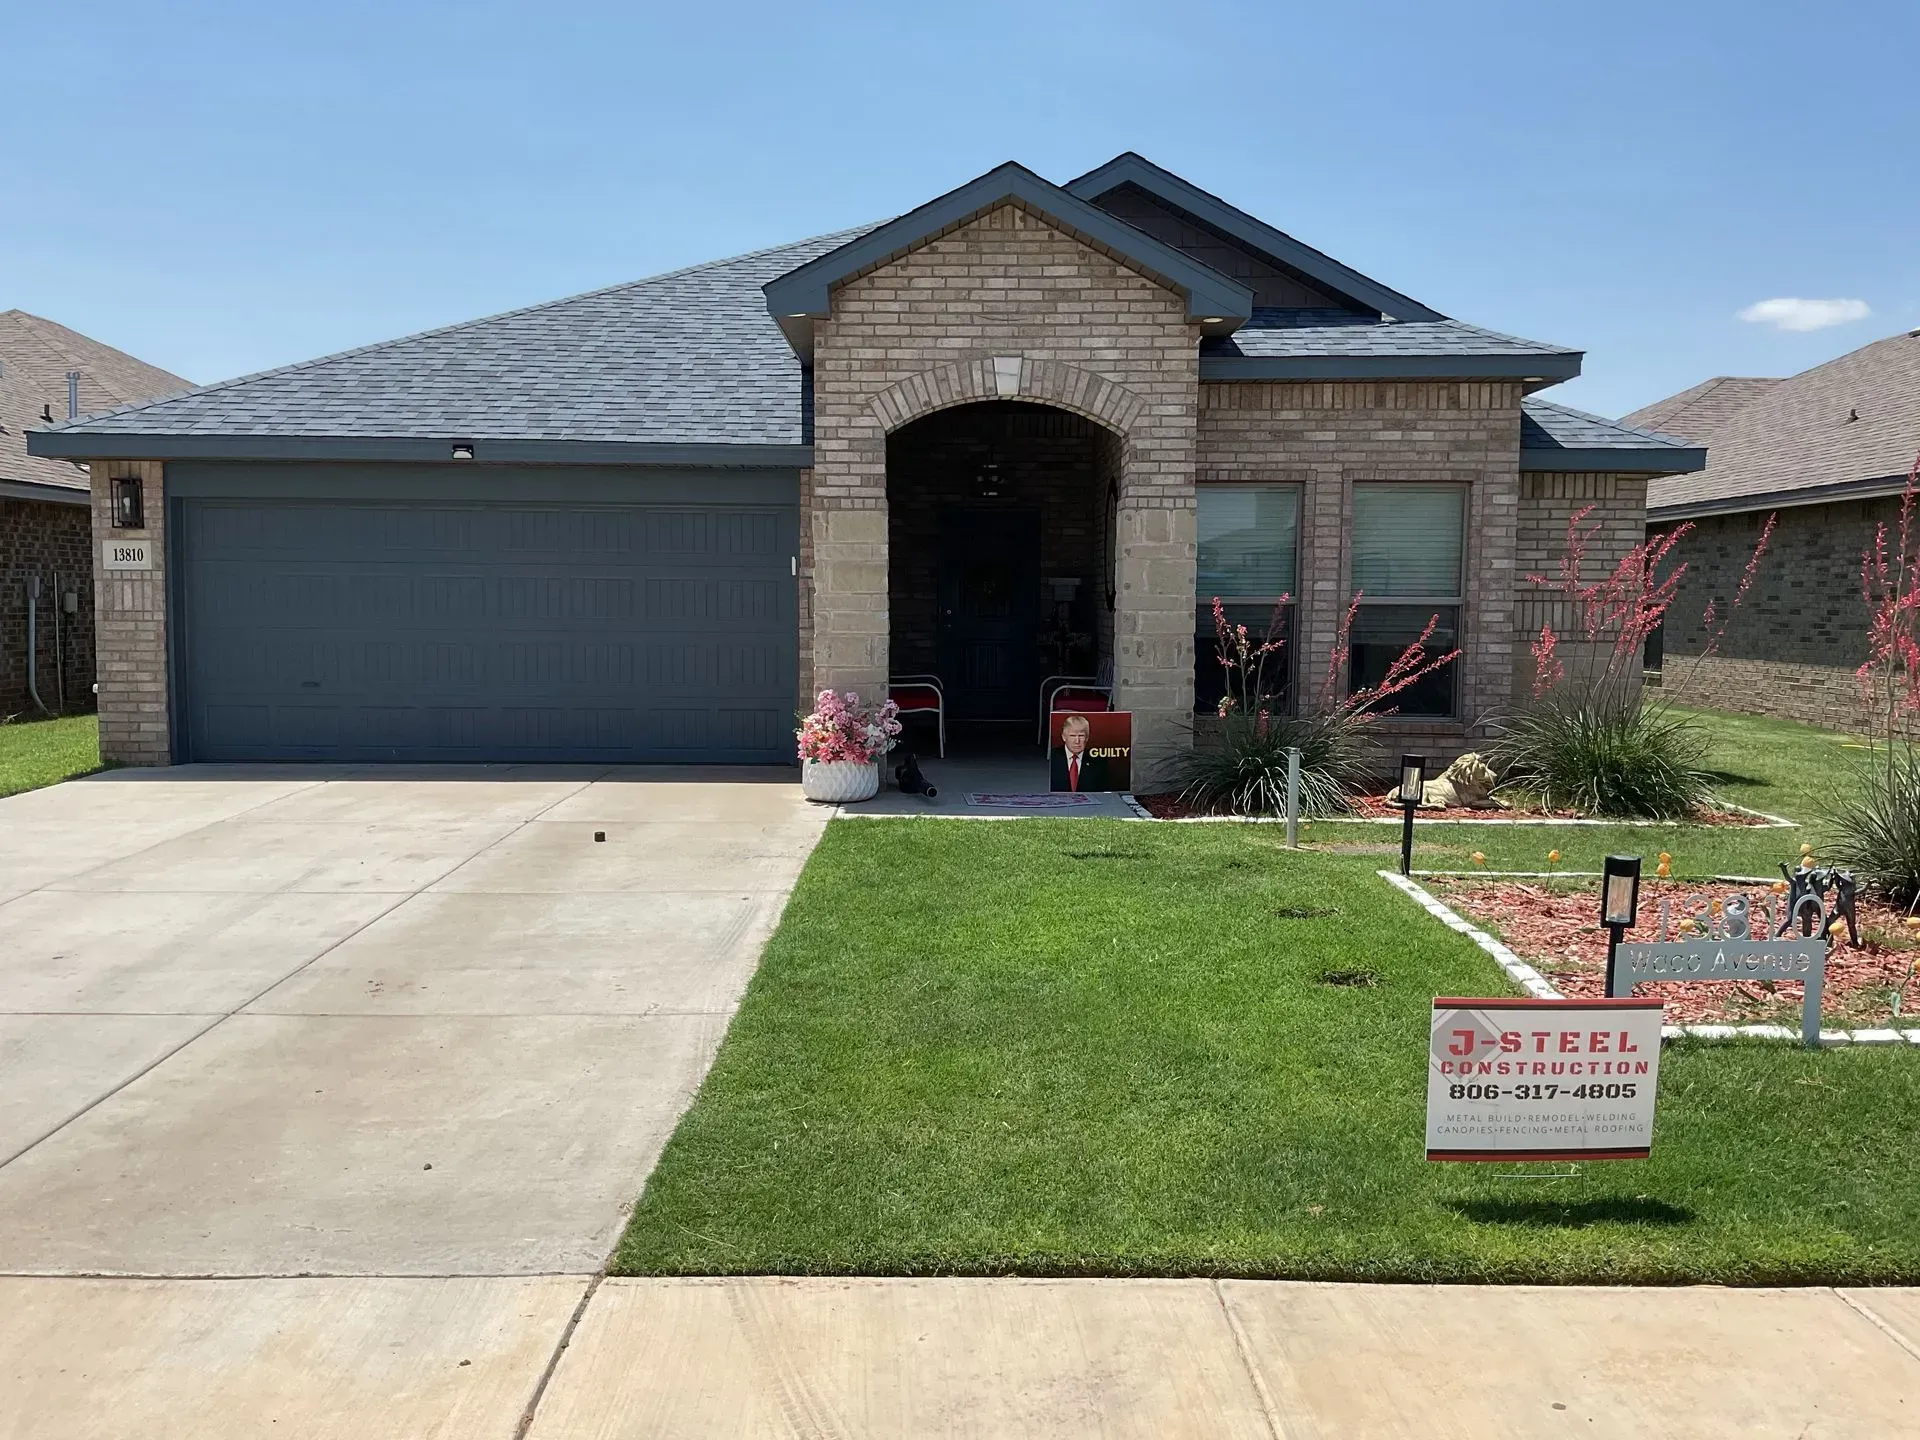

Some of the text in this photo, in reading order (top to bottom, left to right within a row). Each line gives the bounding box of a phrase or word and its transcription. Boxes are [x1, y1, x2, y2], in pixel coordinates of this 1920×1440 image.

[113, 547, 144, 562] 13810
[1089, 747, 1130, 758] GUILTY
[1658, 894, 1826, 942] 13810
[1630, 948, 1810, 973] Waco Avenue
[1448, 1029, 1638, 1056] J-STEEL
[1440, 1060, 1649, 1076] CONSTRUCTION
[1449, 1083, 1637, 1100] 806-317-4805
[1446, 1114, 1482, 1123] METAL
[1594, 1124, 1644, 1133] ROOFING
